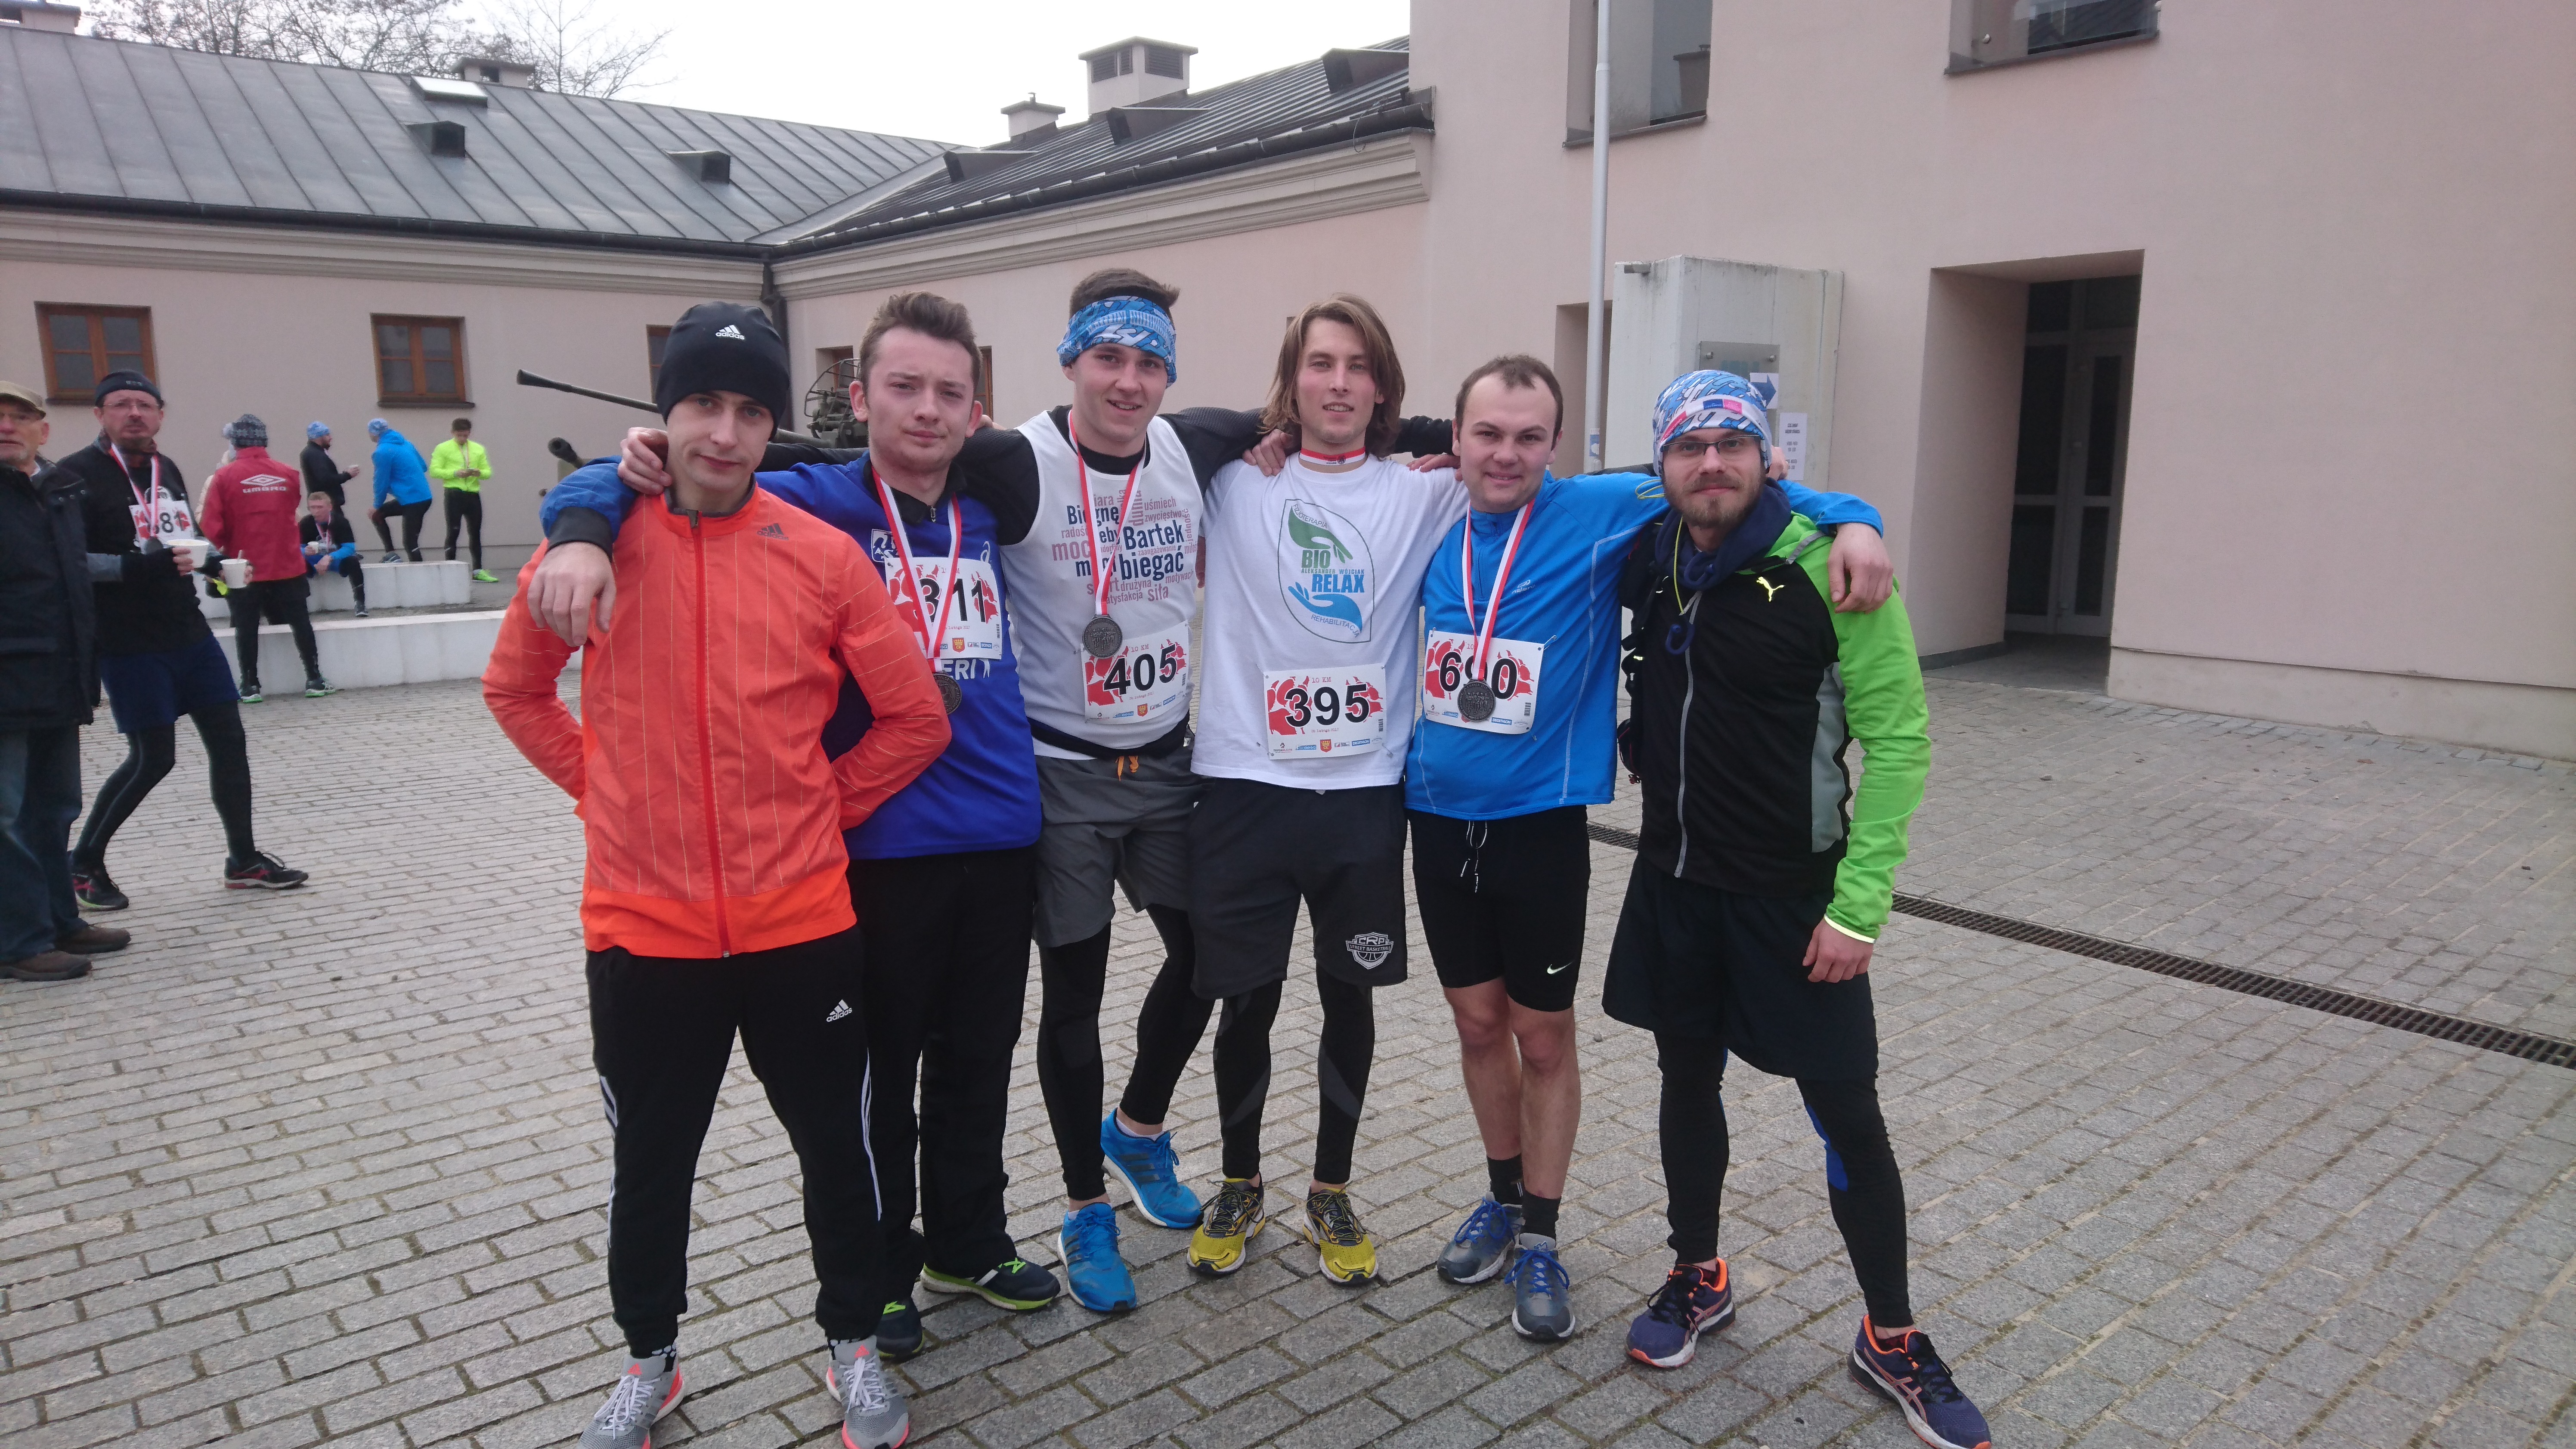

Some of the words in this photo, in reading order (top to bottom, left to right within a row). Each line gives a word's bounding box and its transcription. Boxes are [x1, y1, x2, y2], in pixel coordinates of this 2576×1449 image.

[715, 331, 745, 340] adidas
[1093, 494, 1114, 507] iara
[1144, 496, 1177, 511] uśmiech
[146, 512, 184, 533] 81
[1145, 510, 1182, 523] zwycięstwo
[1293, 504, 1328, 529] FIZJOTERAPIA
[1099, 526, 1120, 545] eby
[1123, 520, 1184, 550] Bartek
[1138, 545, 1176, 556] zaangażowanie
[1301, 549, 1331, 568] BIO
[1118, 545, 1184, 581] biegać
[1121, 579, 1152, 592] drużyna
[1148, 583, 1169, 602] siła
[1312, 574, 1365, 593] RELAX
[1106, 590, 1143, 605] atysfakcja
[1311, 614, 1360, 638] REHABILITACJA
[1103, 644, 1177, 695] 405
[1285, 684, 1369, 727] 395
[1359, 935, 1385, 945] CRP
[826, 1008, 852, 1022] adidas
